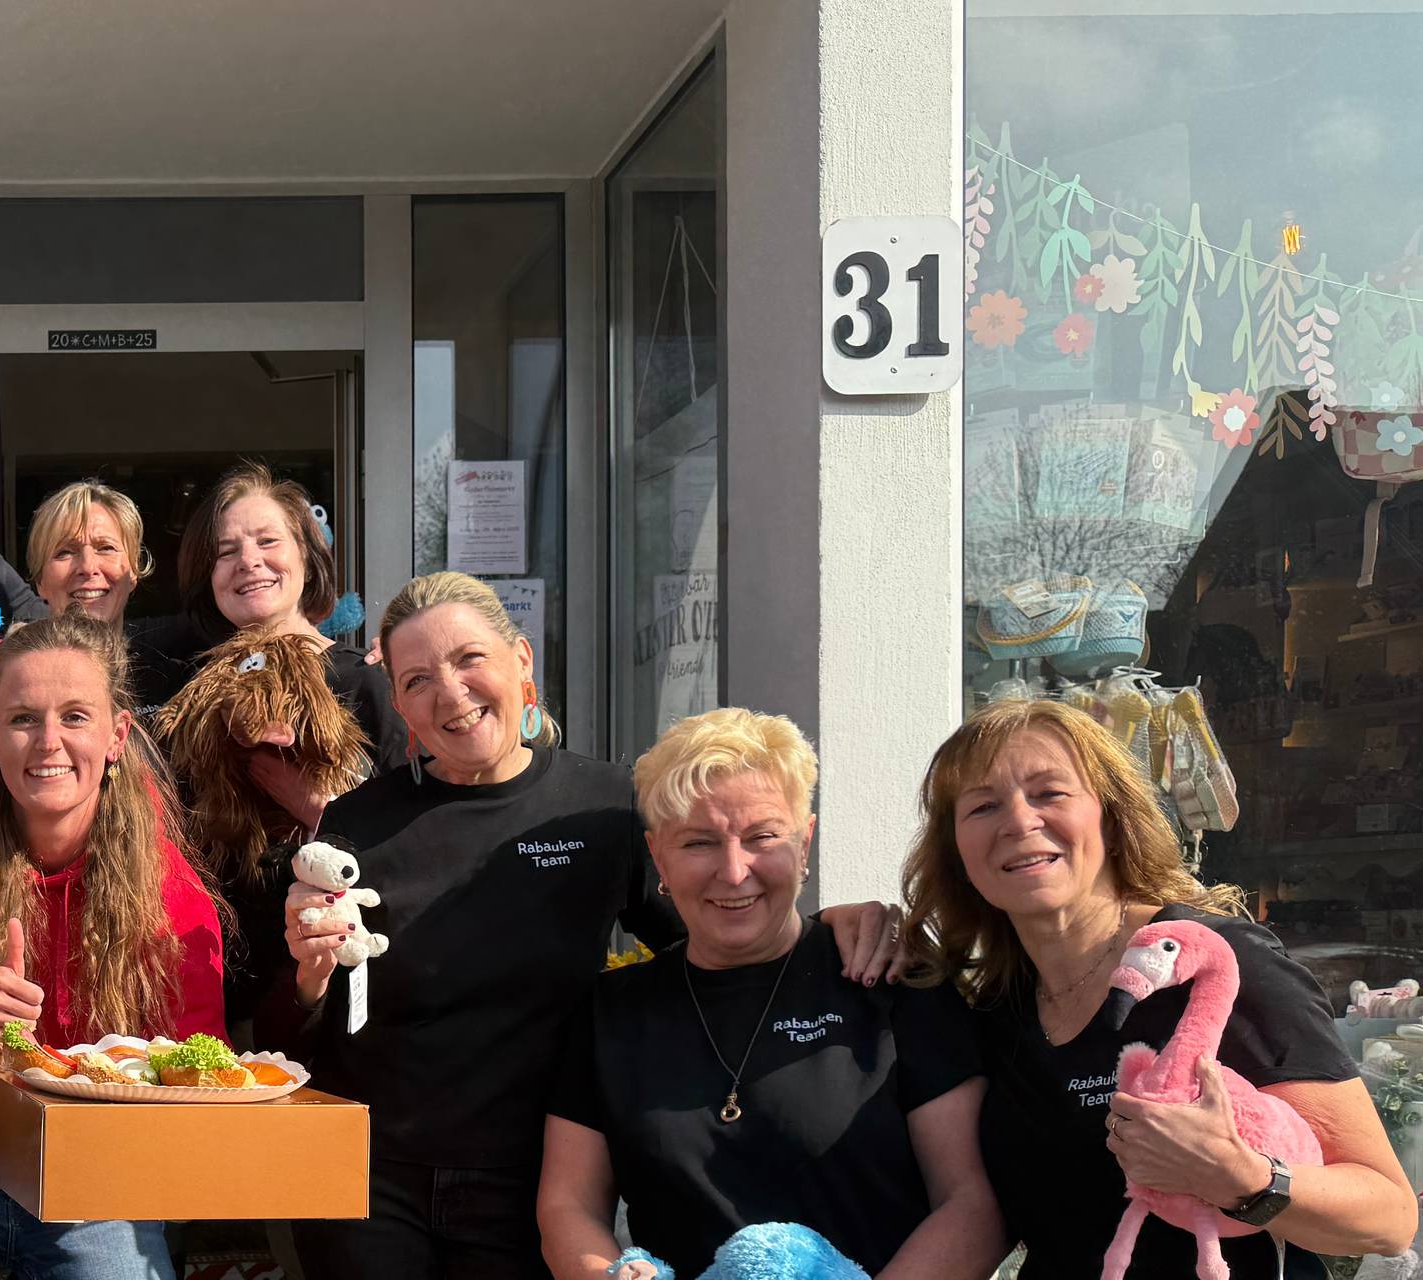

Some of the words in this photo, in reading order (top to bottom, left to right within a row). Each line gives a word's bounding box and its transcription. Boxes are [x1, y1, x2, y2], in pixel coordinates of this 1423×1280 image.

[832, 250, 950, 360] 31
[517, 840, 585, 855] Rabauken
[531, 855, 570, 868] Team
[773, 1013, 843, 1033] Rabauken
[786, 1027, 826, 1042] Team
[1067, 1070, 1118, 1091] Rabauk
